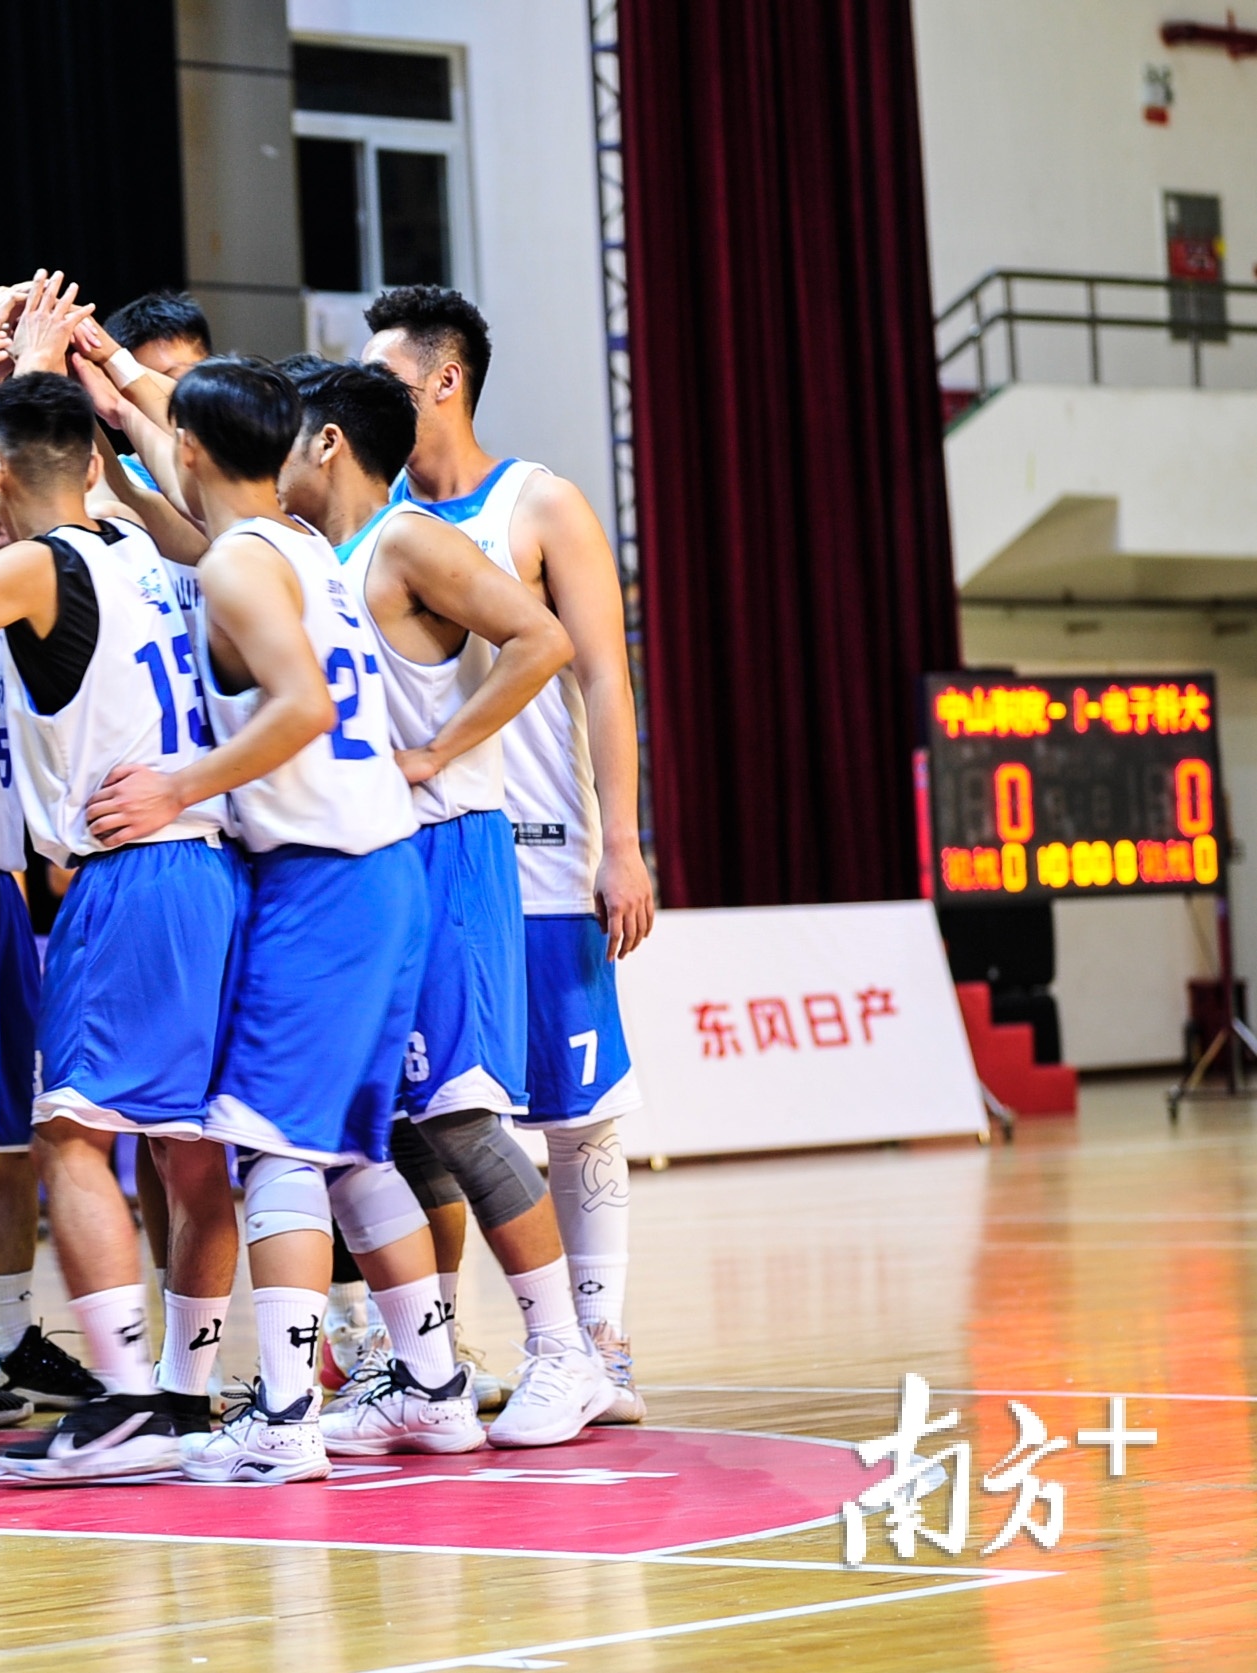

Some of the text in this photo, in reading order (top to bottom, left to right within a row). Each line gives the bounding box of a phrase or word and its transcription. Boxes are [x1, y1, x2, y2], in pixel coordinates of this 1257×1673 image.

[548, 825, 560, 835] XL
[995, 762, 1034, 844] 0
[1175, 759, 1213, 838] 0
[691, 985, 897, 1058] 东风日产
[568, 1029, 598, 1086] 7
[287, 1314, 320, 1369] 中
